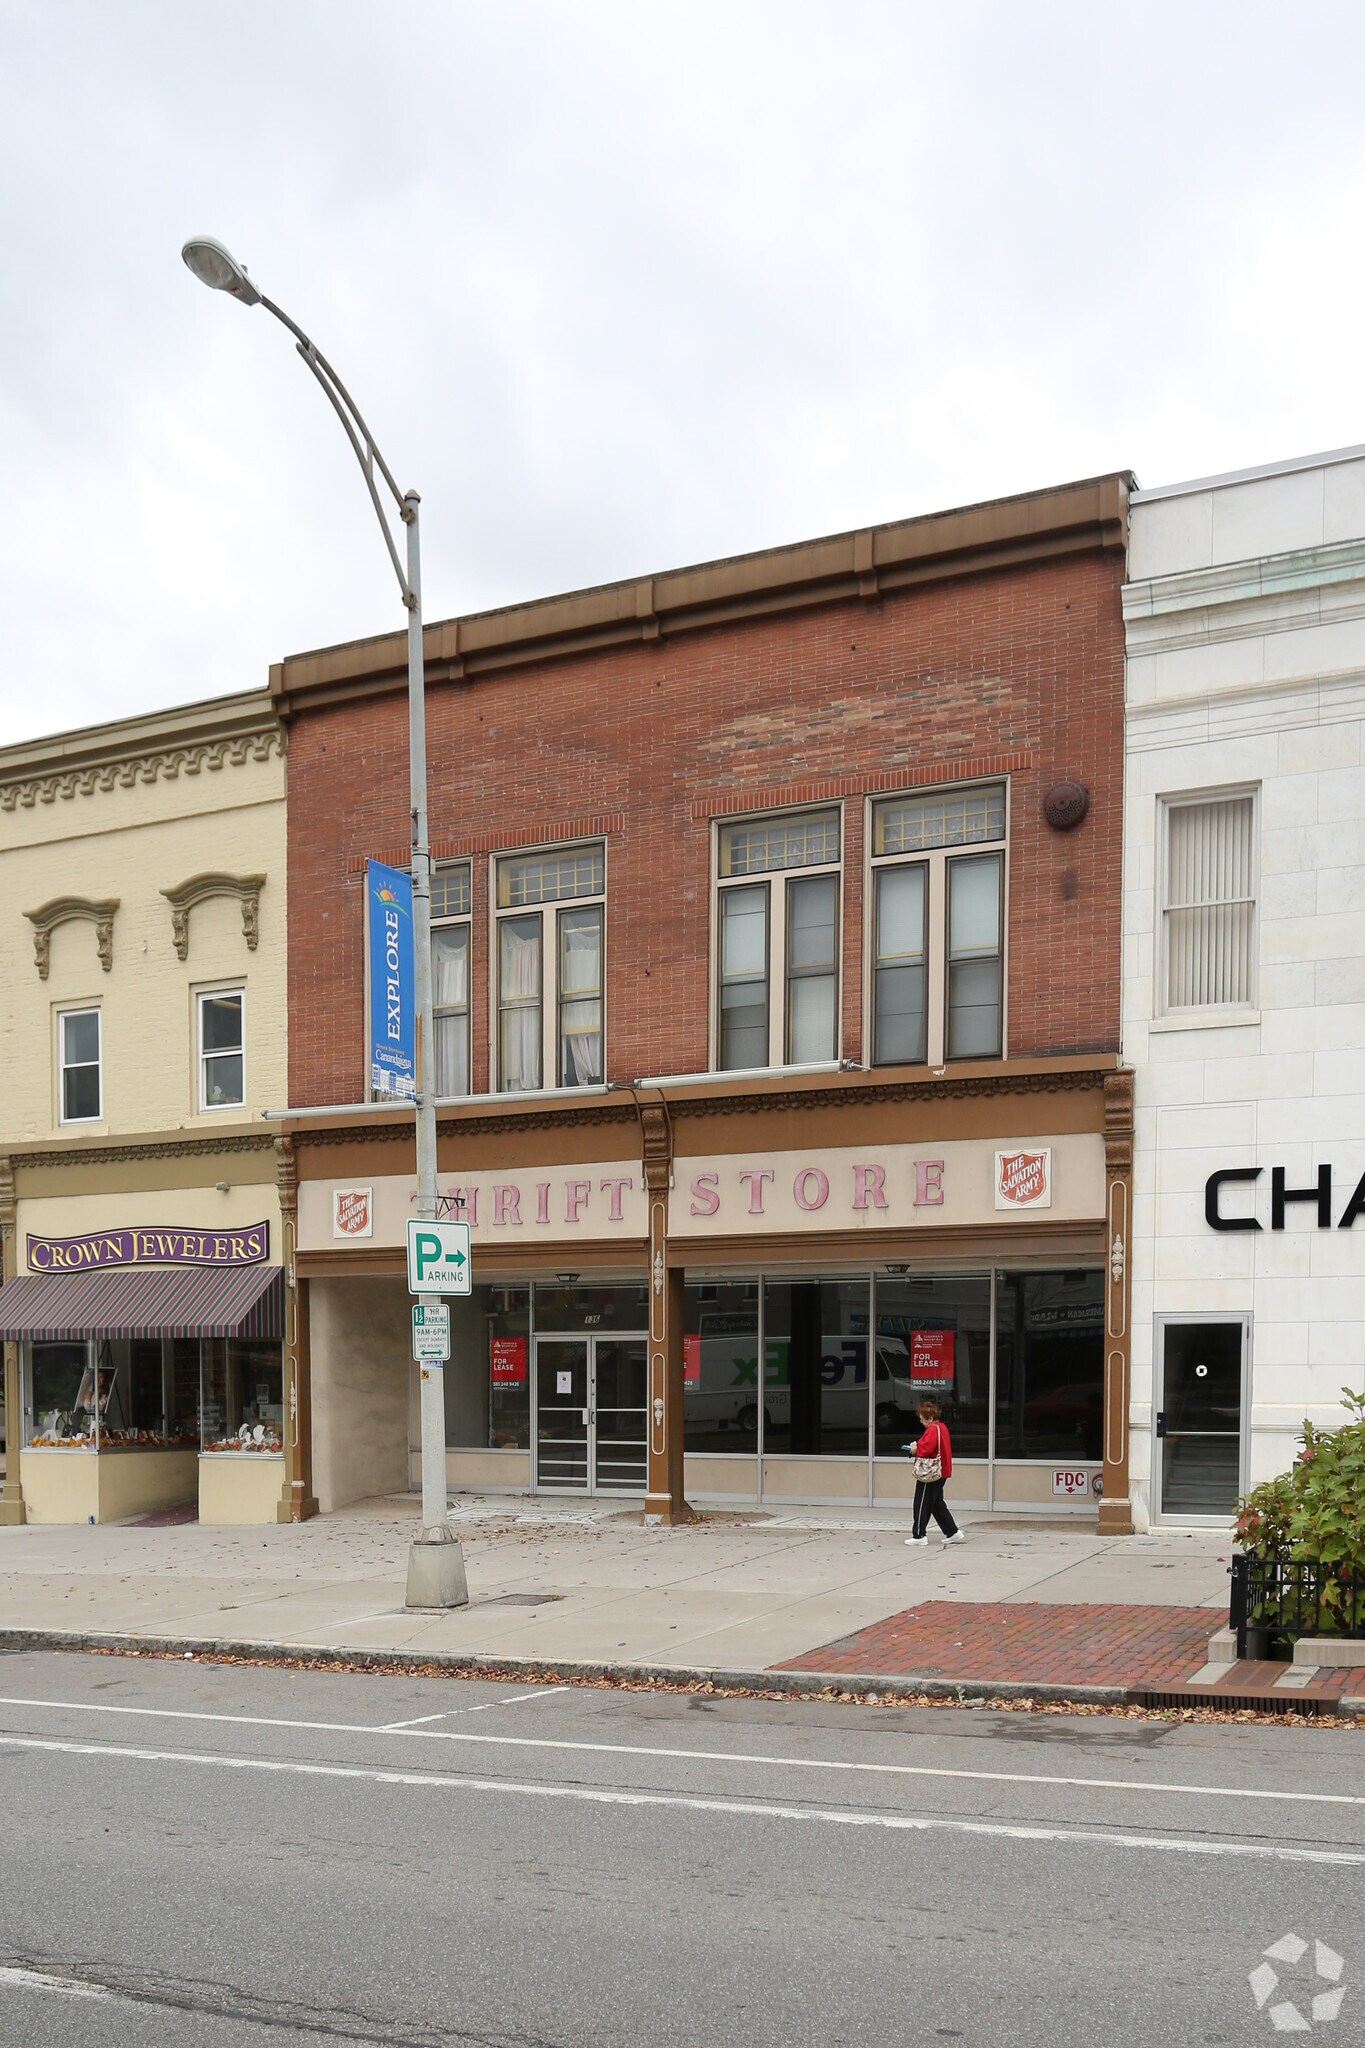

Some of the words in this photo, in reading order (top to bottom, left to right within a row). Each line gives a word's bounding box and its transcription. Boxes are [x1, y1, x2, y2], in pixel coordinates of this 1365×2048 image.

[385, 910, 400, 1042] EXPLORE
[1001, 1157, 1042, 1193] SALVATION
[1006, 1156, 1024, 1176] THE
[690, 1160, 945, 1216] STORE
[1014, 1173, 1040, 1201] ARMY
[338, 1196, 367, 1225] SALVATION
[341, 1194, 355, 1211] THE
[410, 1177, 633, 1227] HRIFT
[346, 1210, 365, 1231] ARMY
[31, 1234, 124, 1269] CROWN
[129, 1231, 262, 1264] JEWELERS
[1055, 1471, 1085, 1487] FDC
